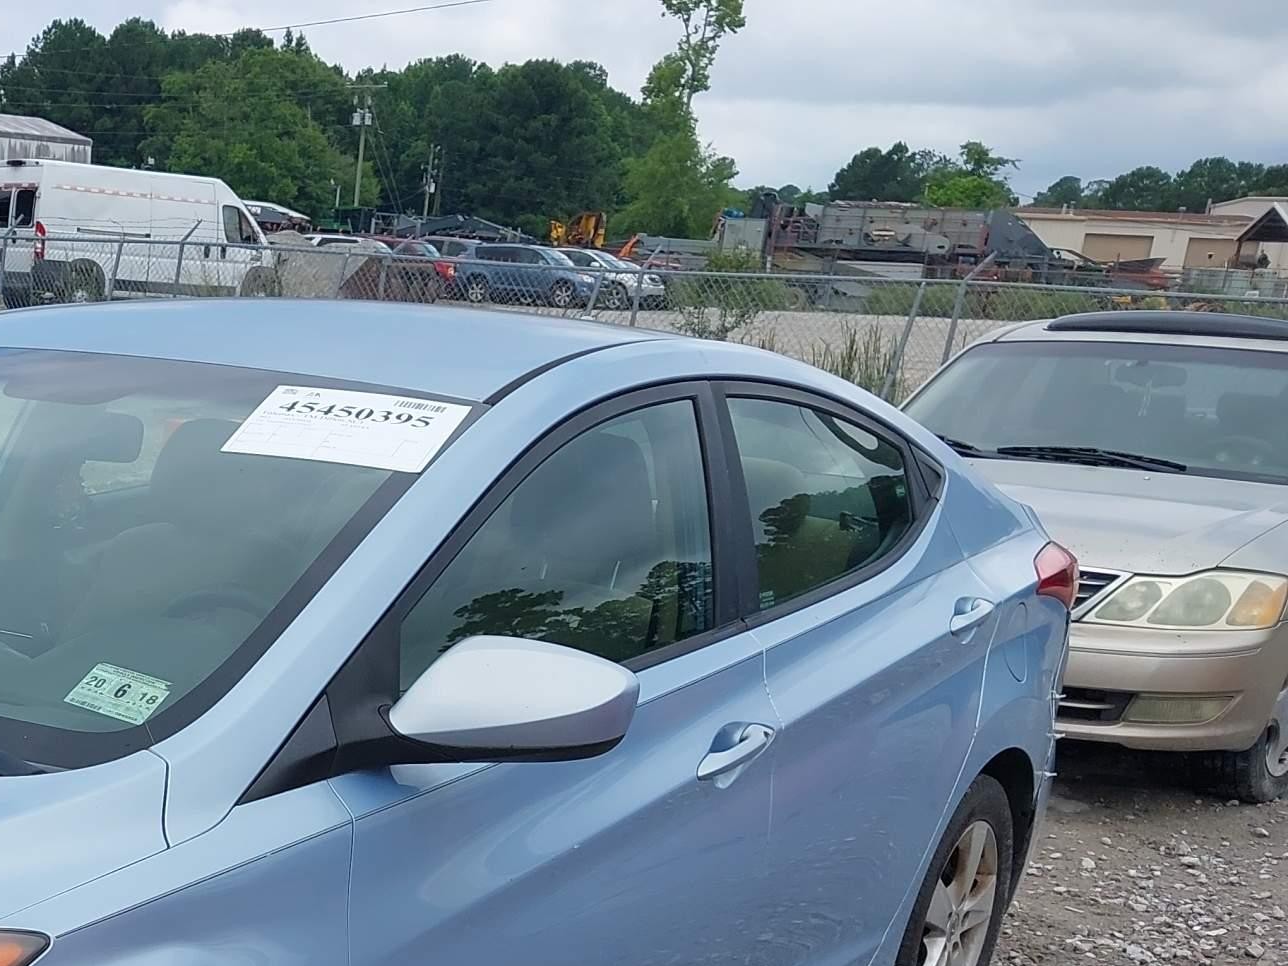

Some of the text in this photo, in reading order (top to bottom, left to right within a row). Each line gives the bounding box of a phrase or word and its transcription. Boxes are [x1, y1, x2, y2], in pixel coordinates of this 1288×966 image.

[279, 400, 435, 428] 45450395
[85, 675, 159, 705] 20 6 18
